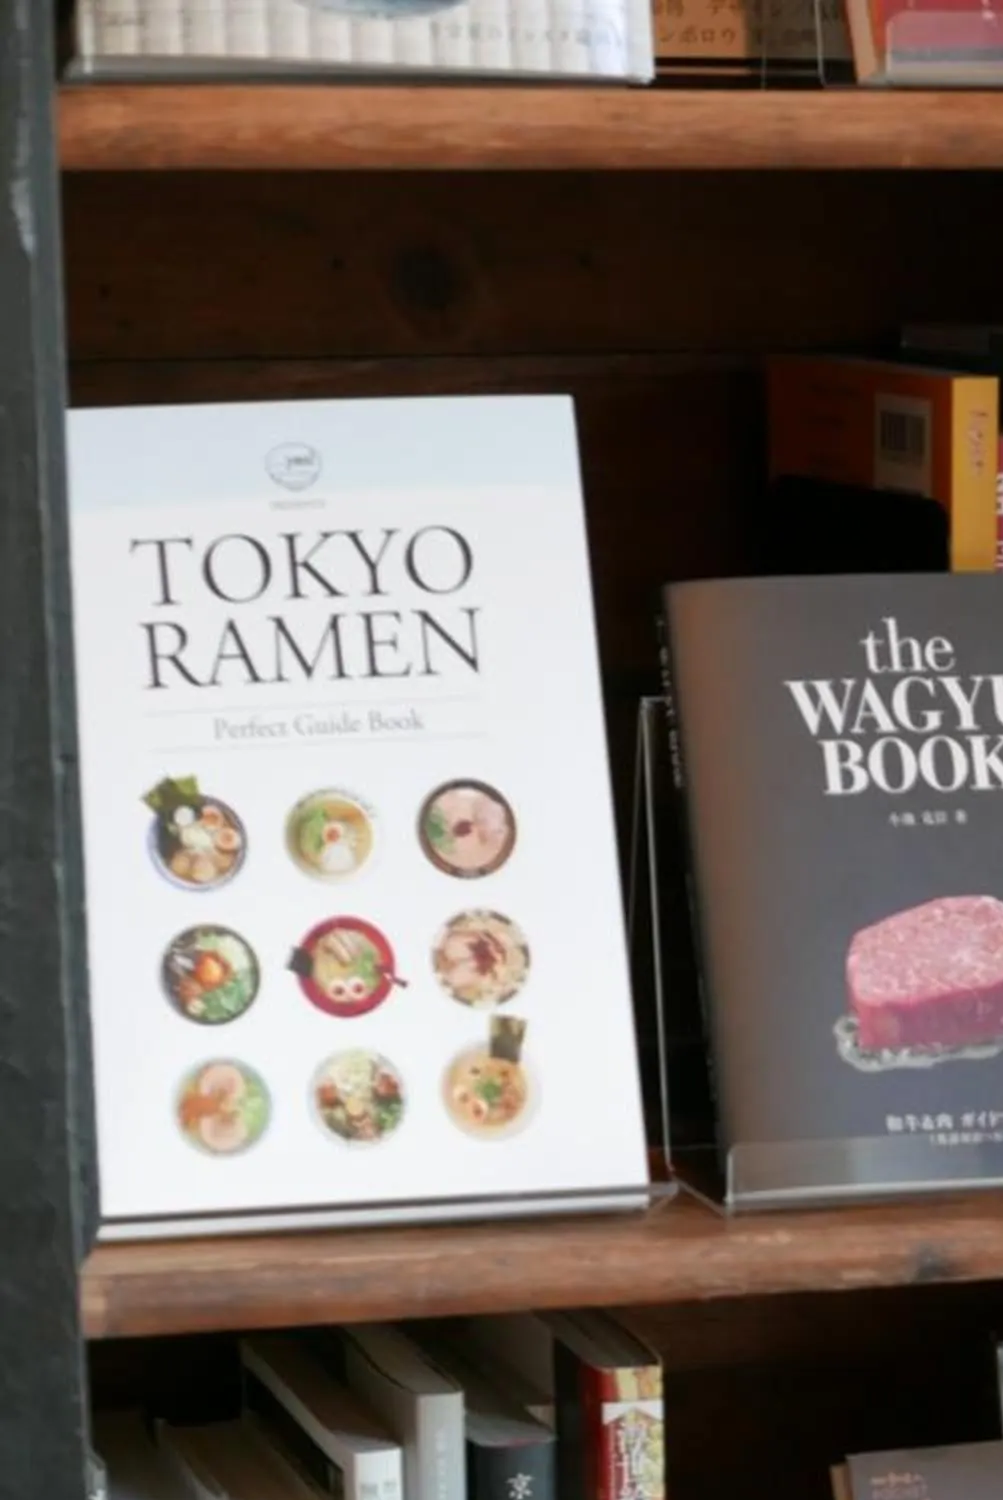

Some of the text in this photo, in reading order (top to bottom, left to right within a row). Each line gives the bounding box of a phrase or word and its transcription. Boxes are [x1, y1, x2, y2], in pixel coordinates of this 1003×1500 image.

[130, 524, 475, 607] TOKYO
[138, 606, 483, 690] RAMEN
[858, 616, 957, 674] the
[212, 708, 425, 741] Perfect Guide Book
